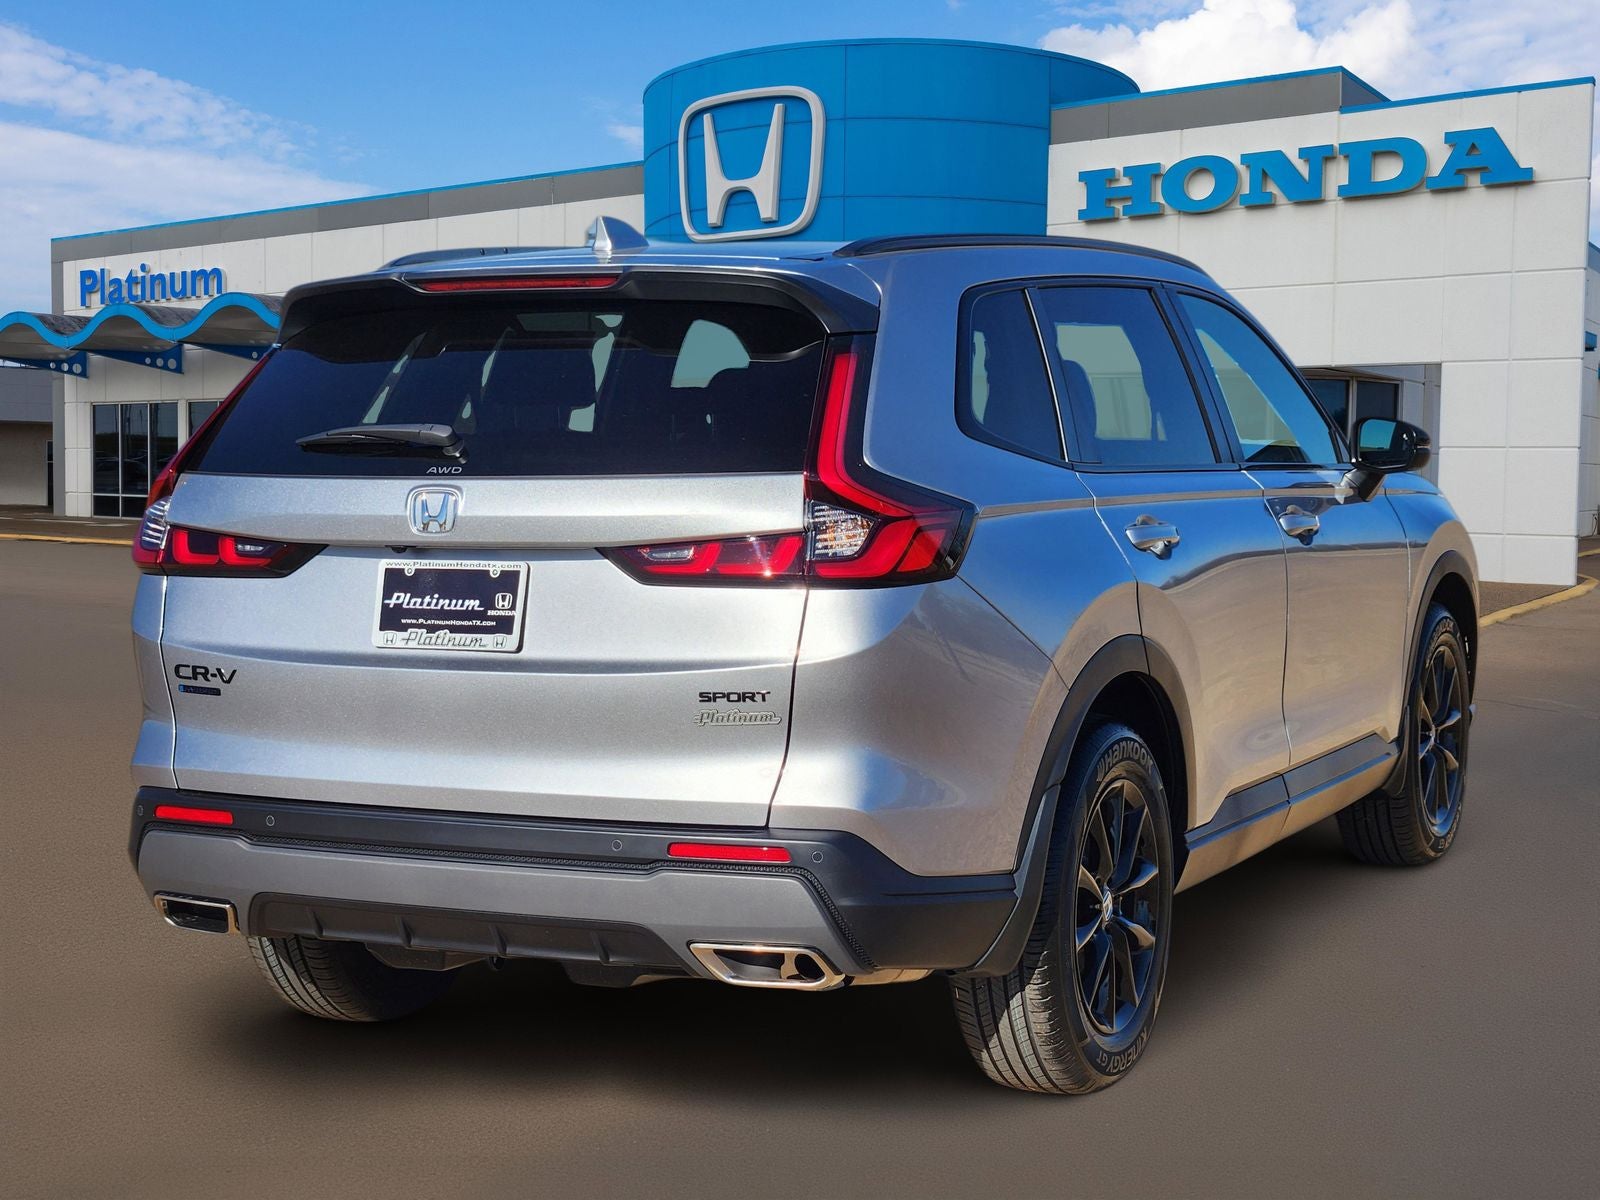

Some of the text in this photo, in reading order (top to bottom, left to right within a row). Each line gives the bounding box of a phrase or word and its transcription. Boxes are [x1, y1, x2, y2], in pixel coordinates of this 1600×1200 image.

[1078, 127, 1534, 222] HONDA
[79, 262, 227, 308] Platinum
[426, 466, 463, 474] AWD
[384, 592, 485, 611] Platinum
[401, 630, 489, 648] Platinum
[174, 664, 237, 684] CR-V
[698, 691, 771, 703] SPORT
[693, 709, 782, 726] Platinum
